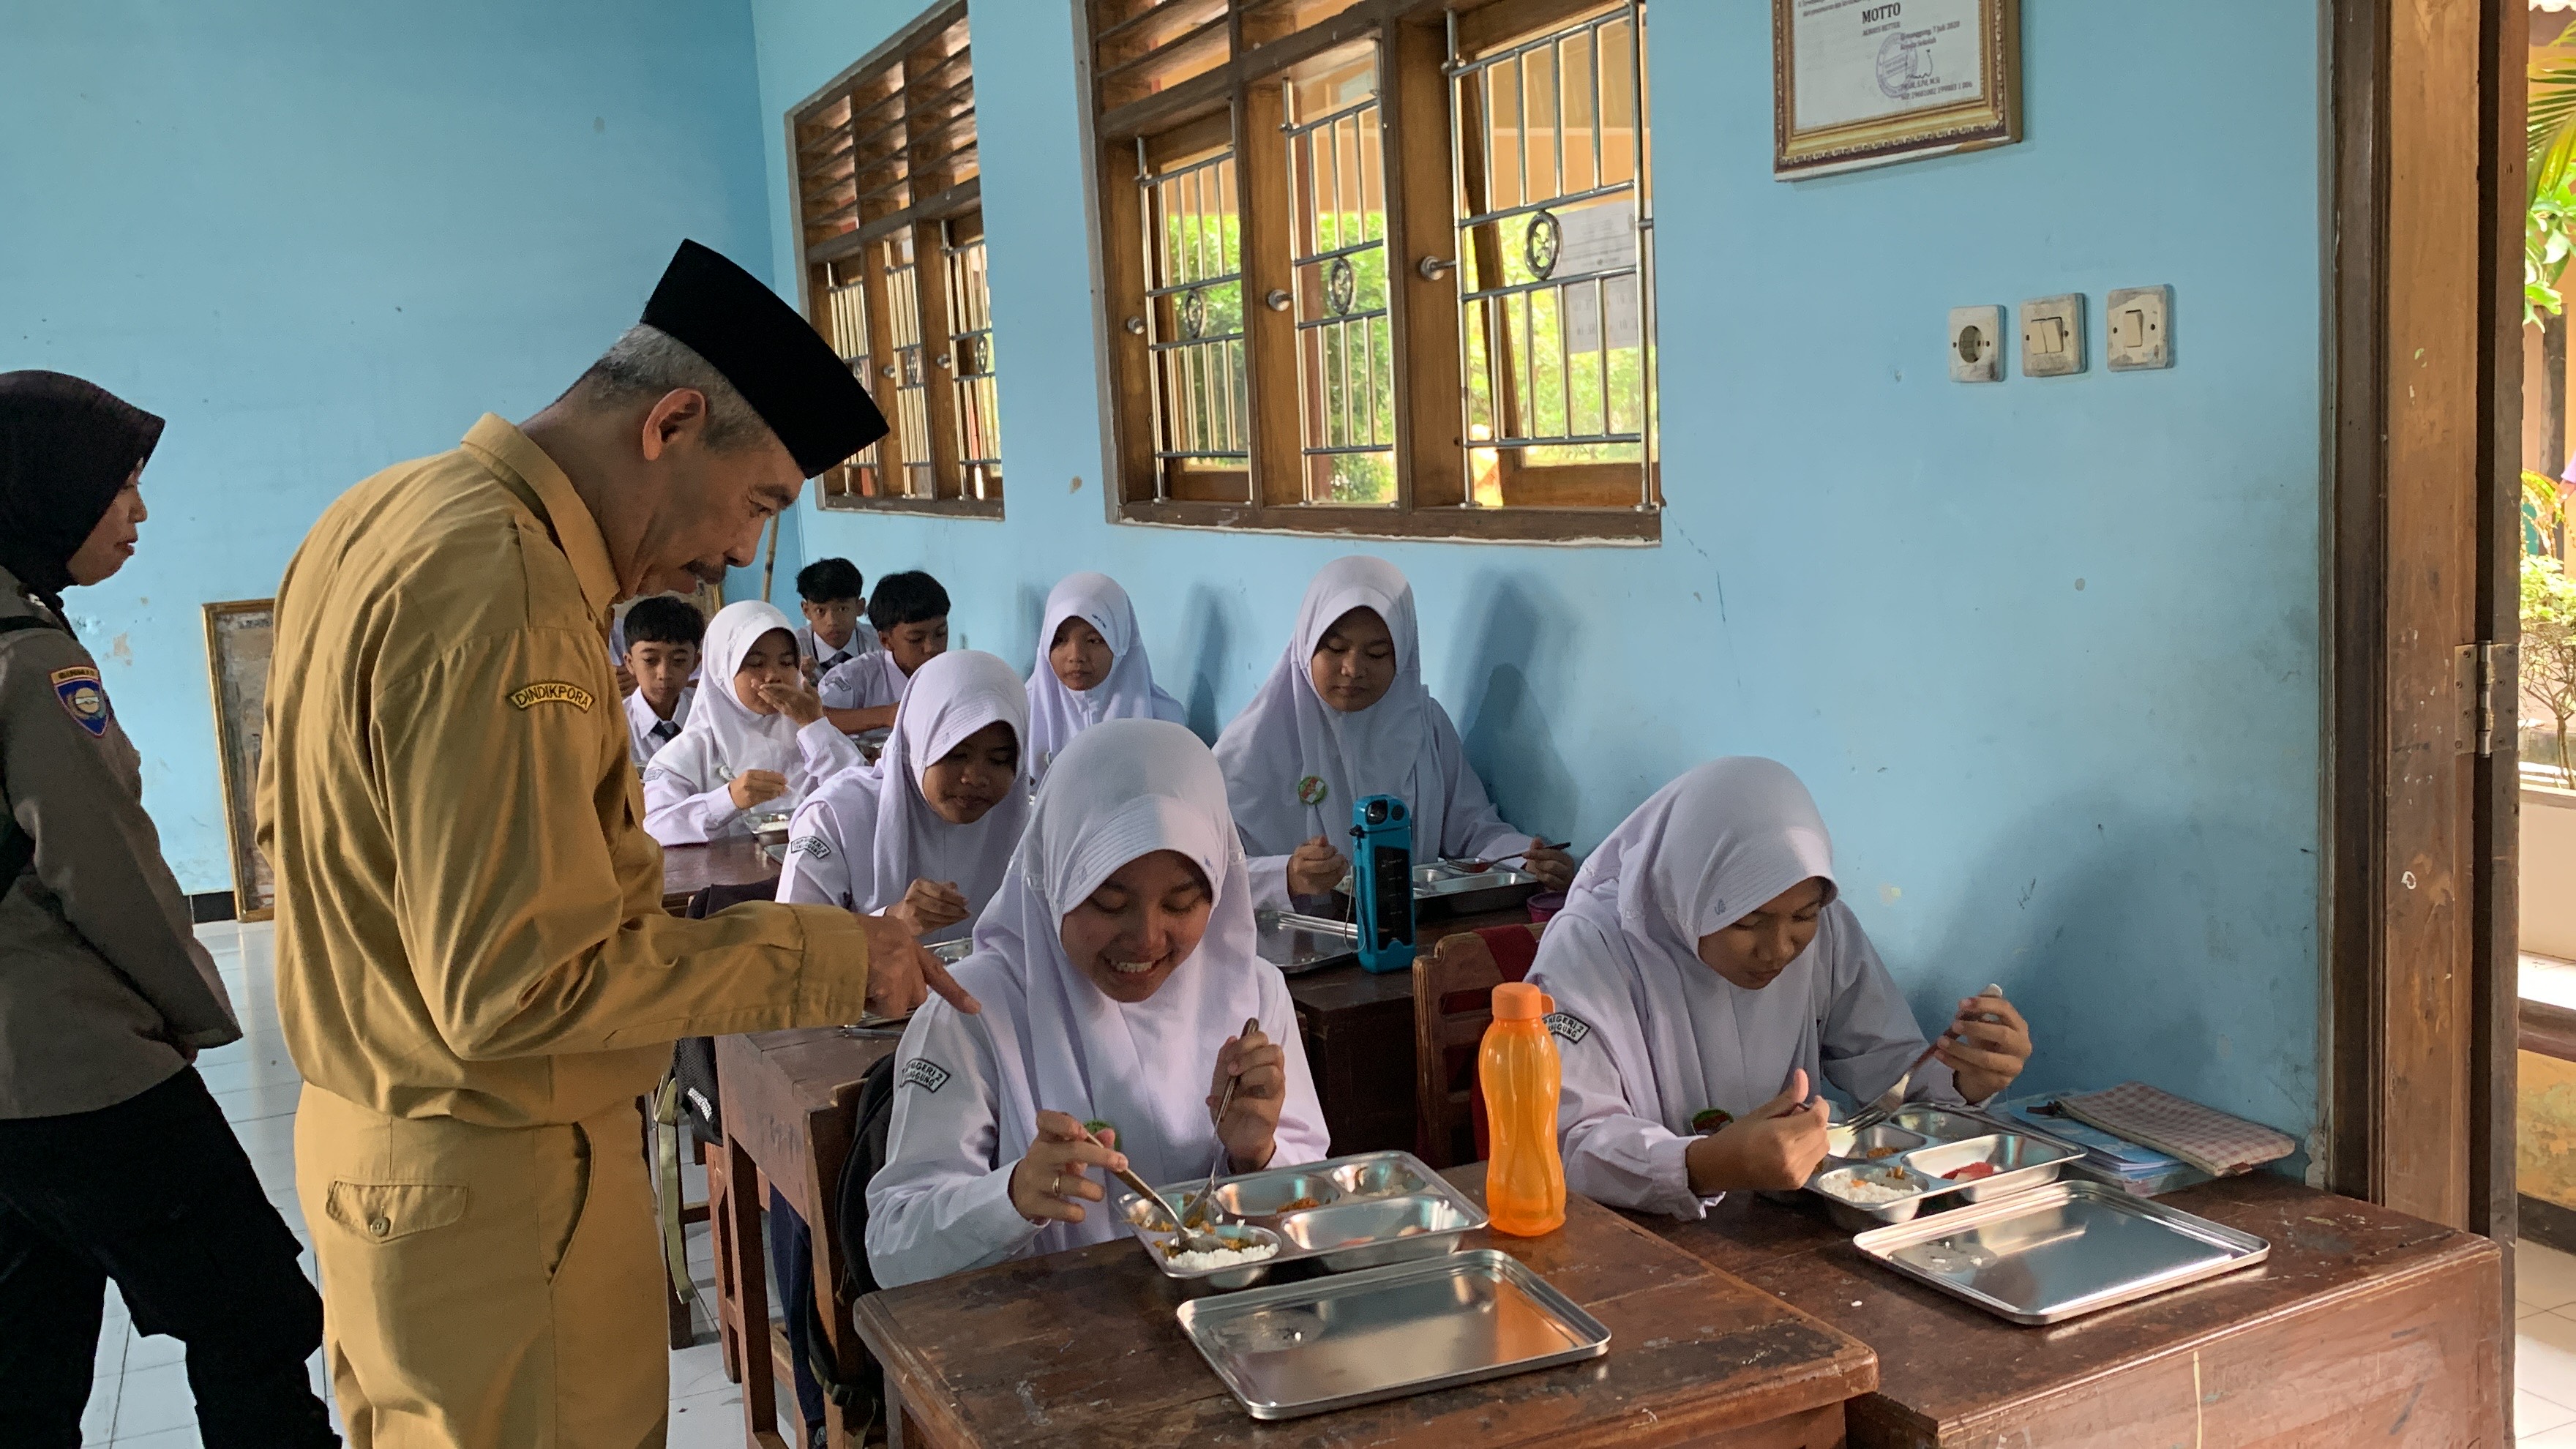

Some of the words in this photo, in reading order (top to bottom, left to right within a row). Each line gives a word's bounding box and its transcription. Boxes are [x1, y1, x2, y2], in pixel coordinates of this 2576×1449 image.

[1862, 2, 1901, 23] MOTTO
[516, 684, 588, 705] DINDIKPORA
[1576, 1025, 1584, 1033] 2
[935, 1072, 943, 1082] 2
